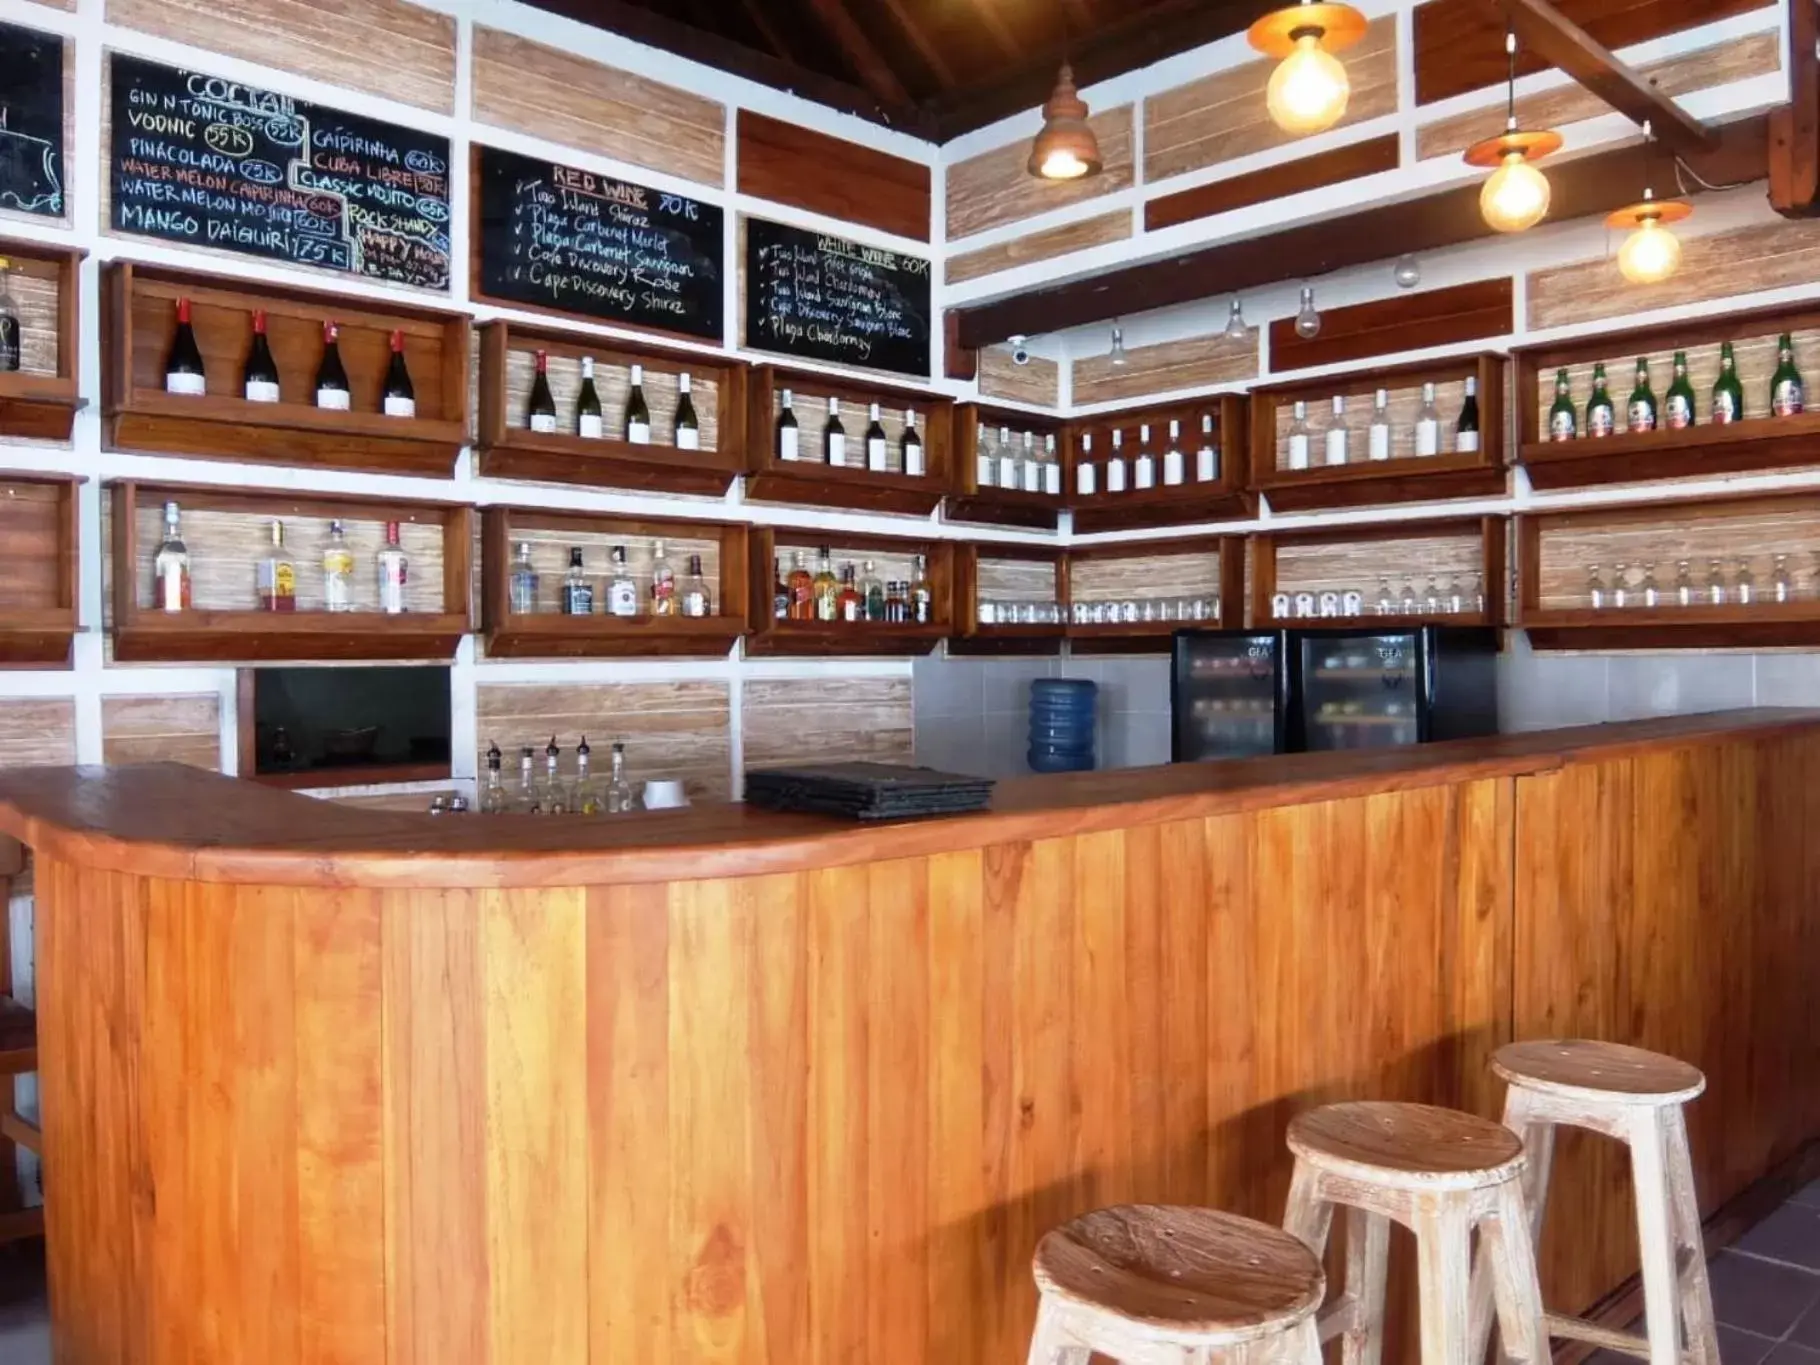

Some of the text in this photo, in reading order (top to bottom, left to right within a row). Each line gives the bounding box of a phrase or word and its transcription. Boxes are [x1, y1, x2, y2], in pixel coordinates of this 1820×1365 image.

[129, 88, 158, 105] GIN
[163, 94, 176, 110] N
[178, 98, 228, 123] TONIC
[127, 108, 197, 139] VODNIC
[313, 151, 361, 174] CUBA
[366, 163, 413, 188] LIBRE
[522, 179, 557, 204] Two
[553, 164, 597, 192] RED
[602, 178, 649, 211] WINE
[120, 202, 199, 235] MANGO
[347, 202, 388, 228] ROCK
[361, 227, 412, 262] HAPPY
[529, 261, 688, 315] Cape Discovery Shiraz
